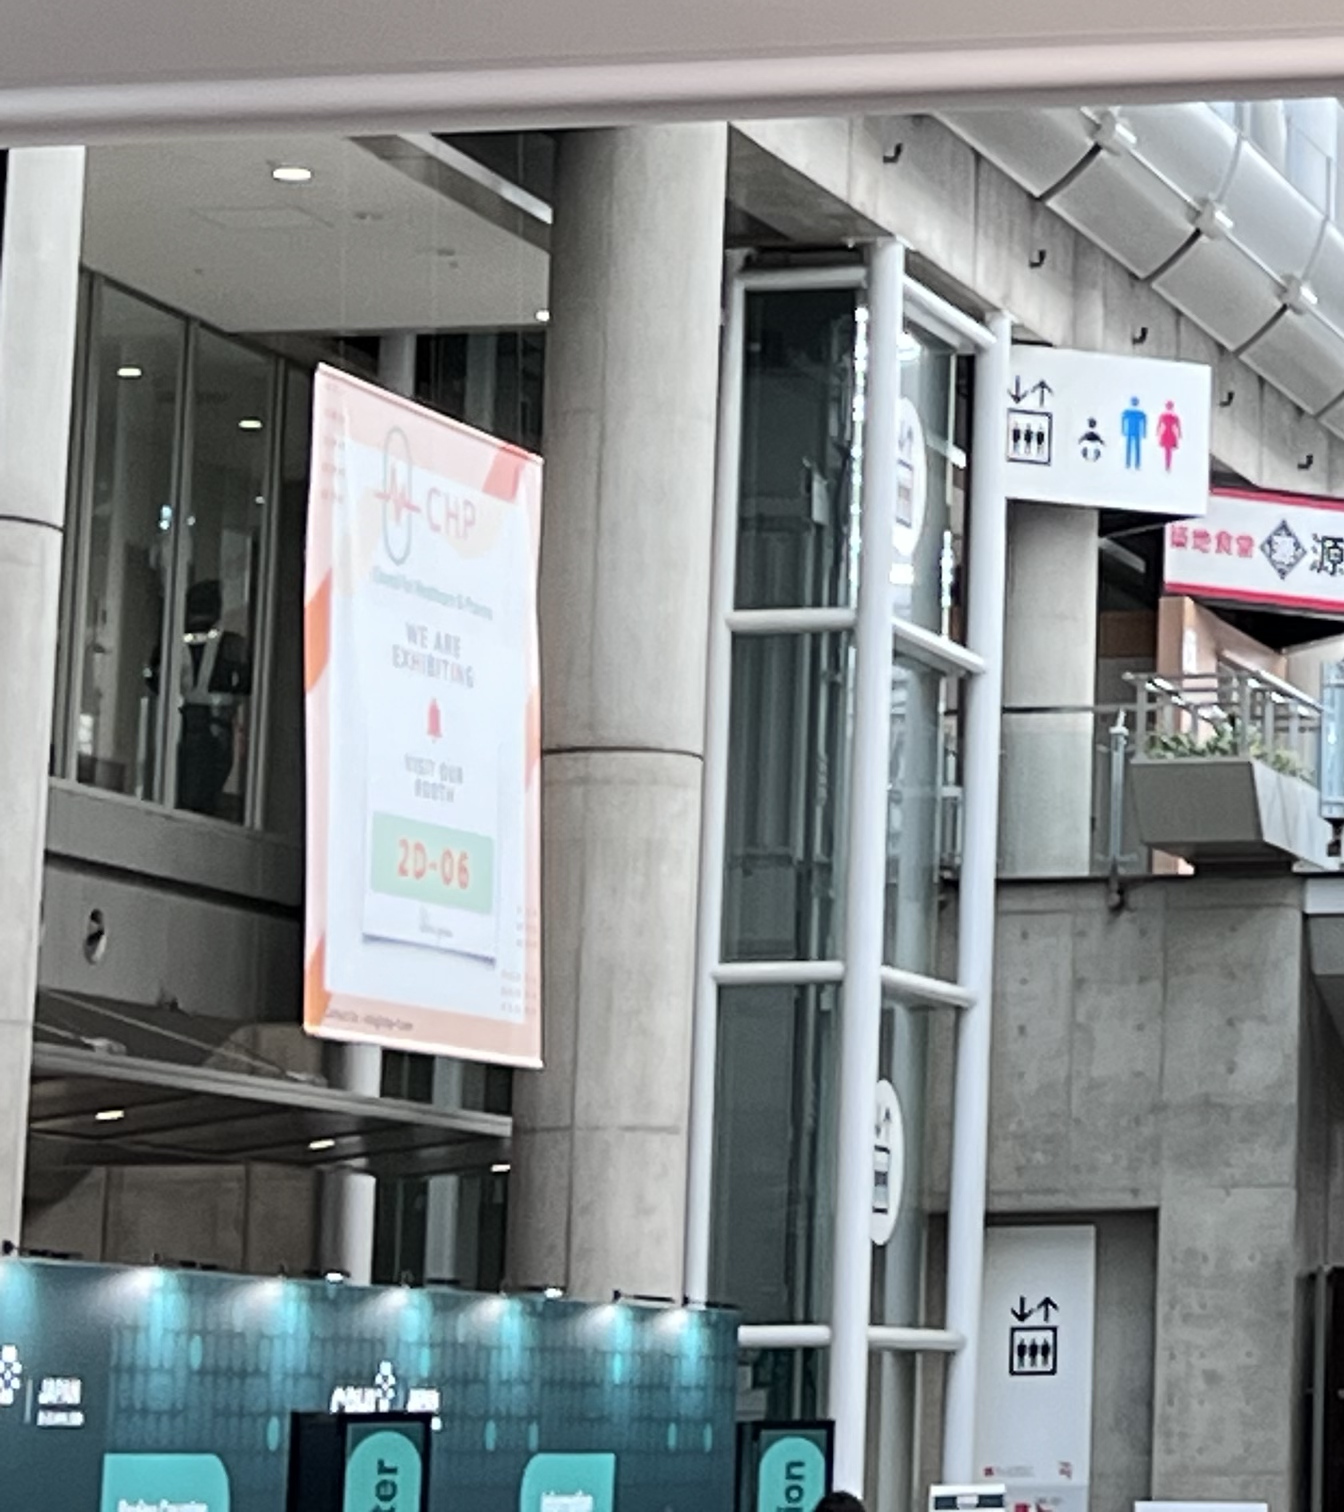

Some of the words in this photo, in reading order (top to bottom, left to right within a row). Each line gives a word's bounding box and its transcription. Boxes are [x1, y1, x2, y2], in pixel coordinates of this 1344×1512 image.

[426, 487, 476, 539] CHP
[405, 621, 429, 650] WE
[433, 631, 462, 660] ARE
[391, 644, 475, 689] EXHIBITING
[397, 838, 471, 891] 2D-06
